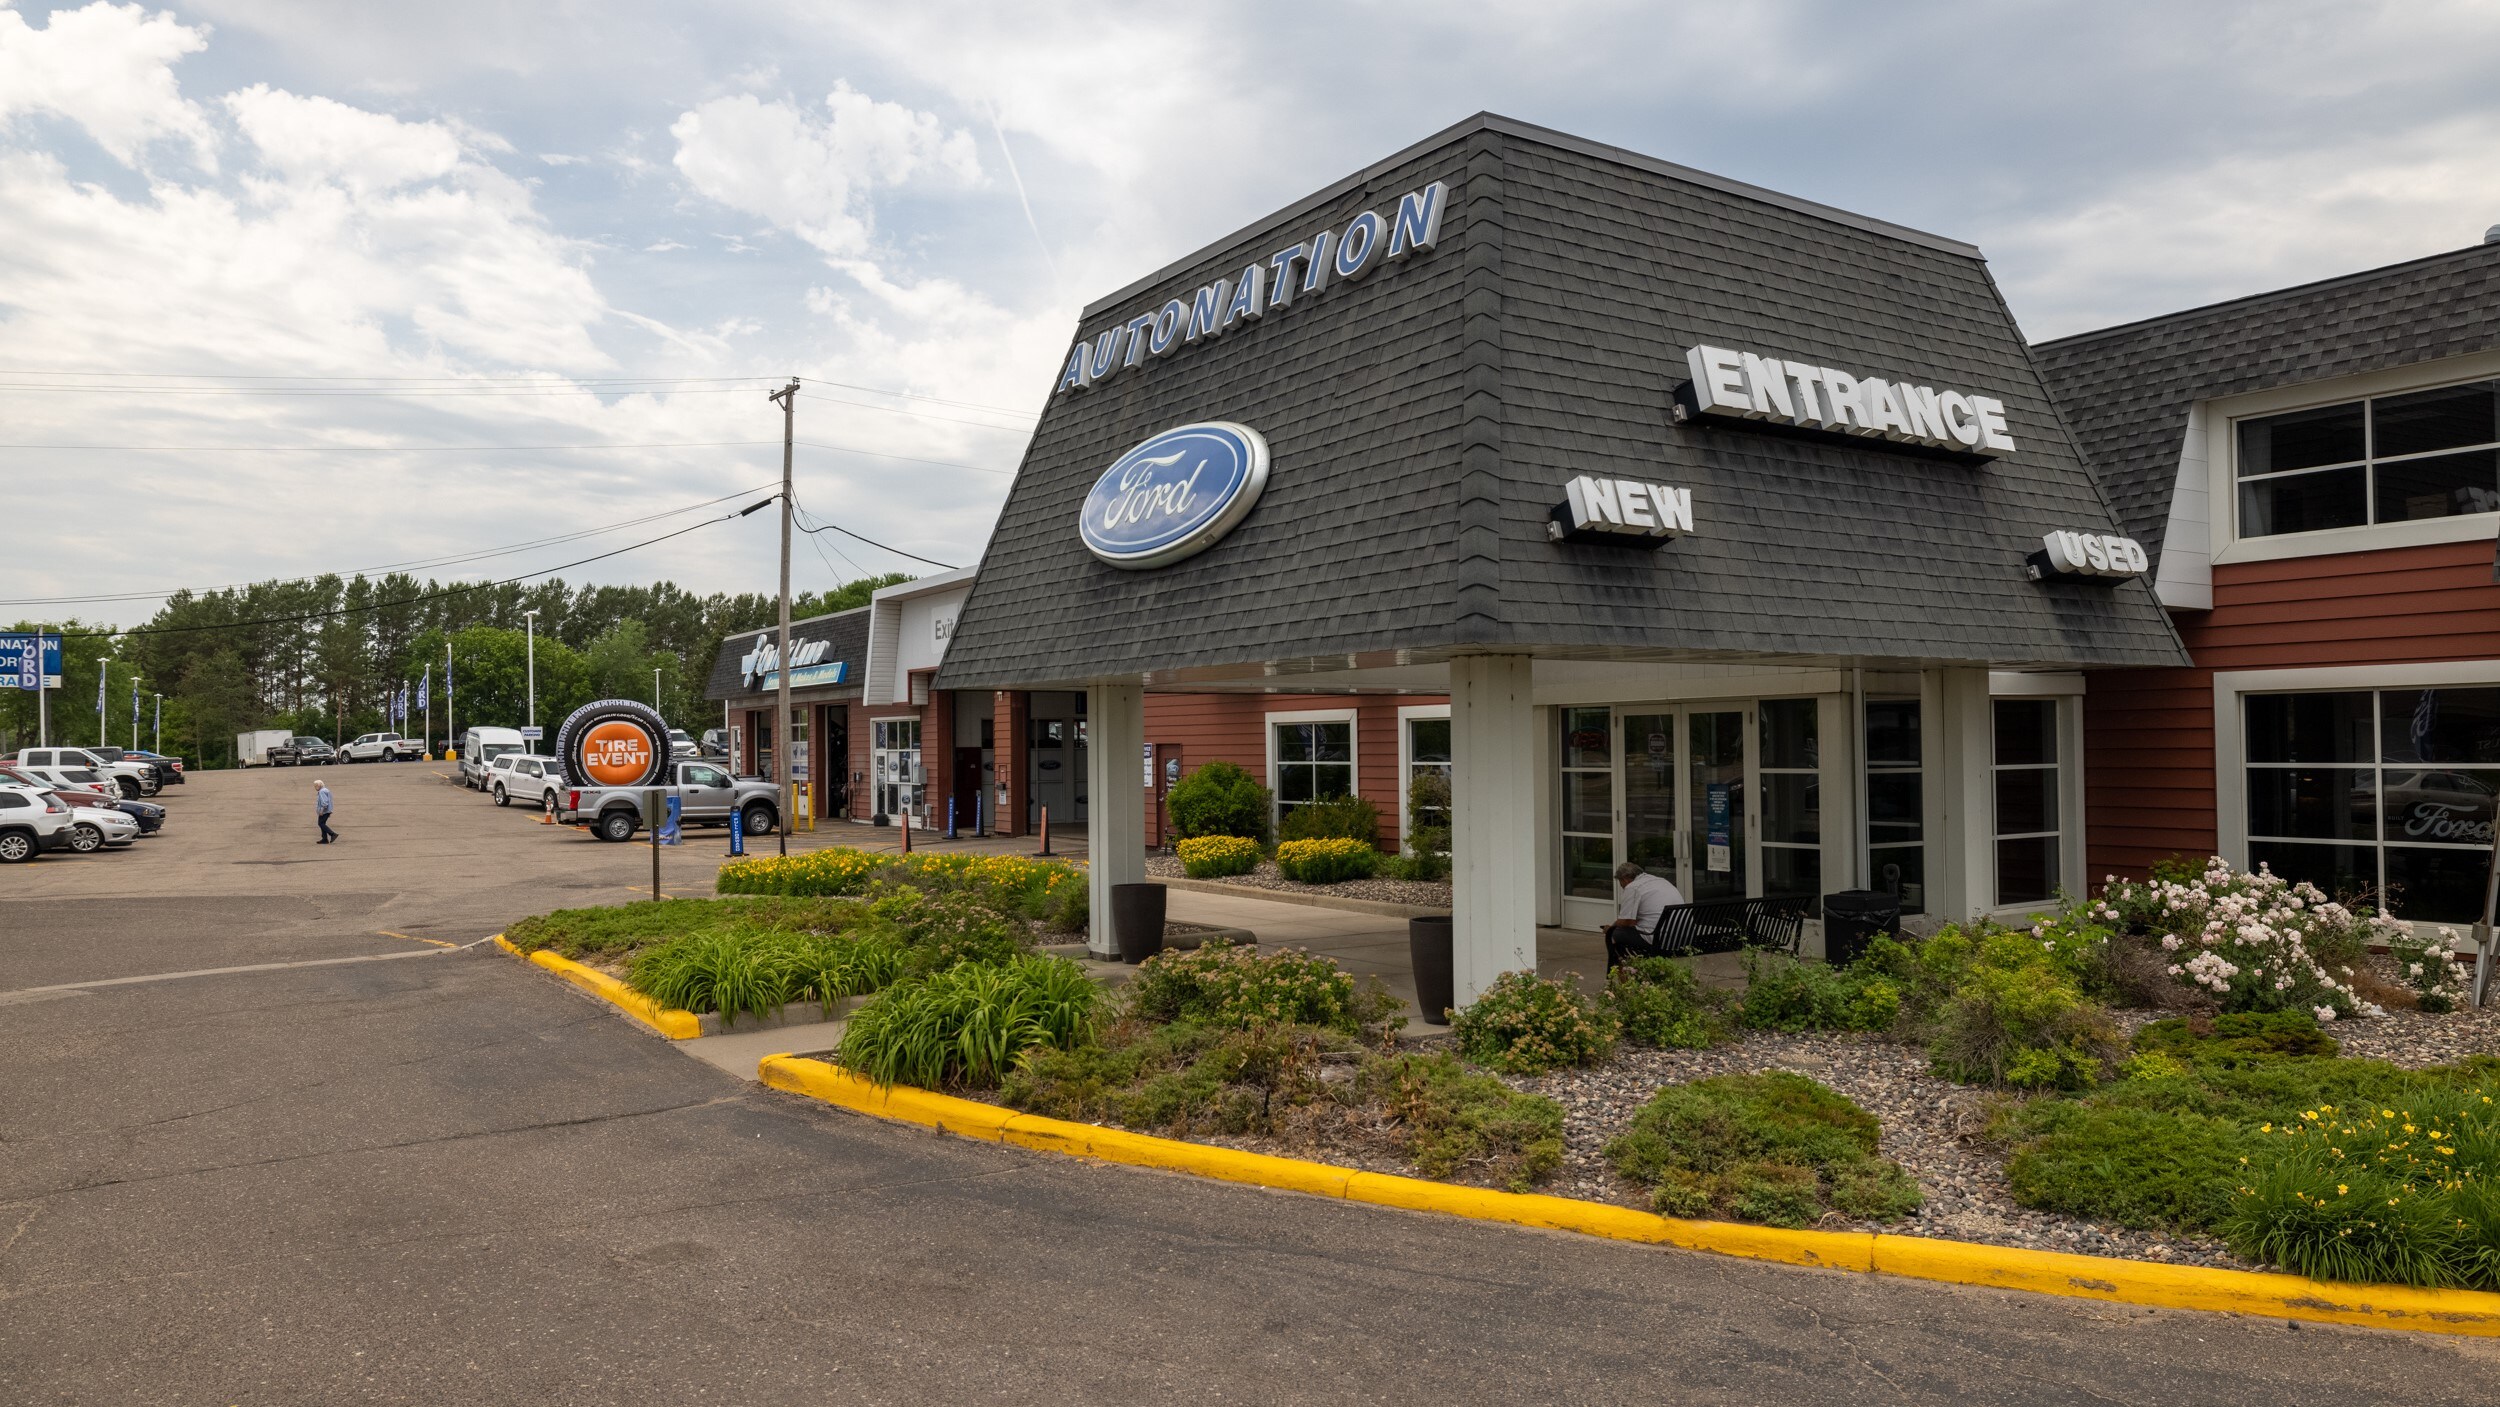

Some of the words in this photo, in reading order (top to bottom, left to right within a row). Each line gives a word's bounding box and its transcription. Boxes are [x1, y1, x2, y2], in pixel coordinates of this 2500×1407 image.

[1058, 180, 1449, 395] AUTONATION
[1688, 344, 2016, 454] ENTRANCE
[1103, 449, 1208, 530] Ford
[1567, 475, 1693, 535] NEW
[2044, 530, 2149, 575] USED
[22, 637, 37, 687] ORD
[587, 752, 649, 766] EVENT
[595, 739, 638, 753] TIRE
